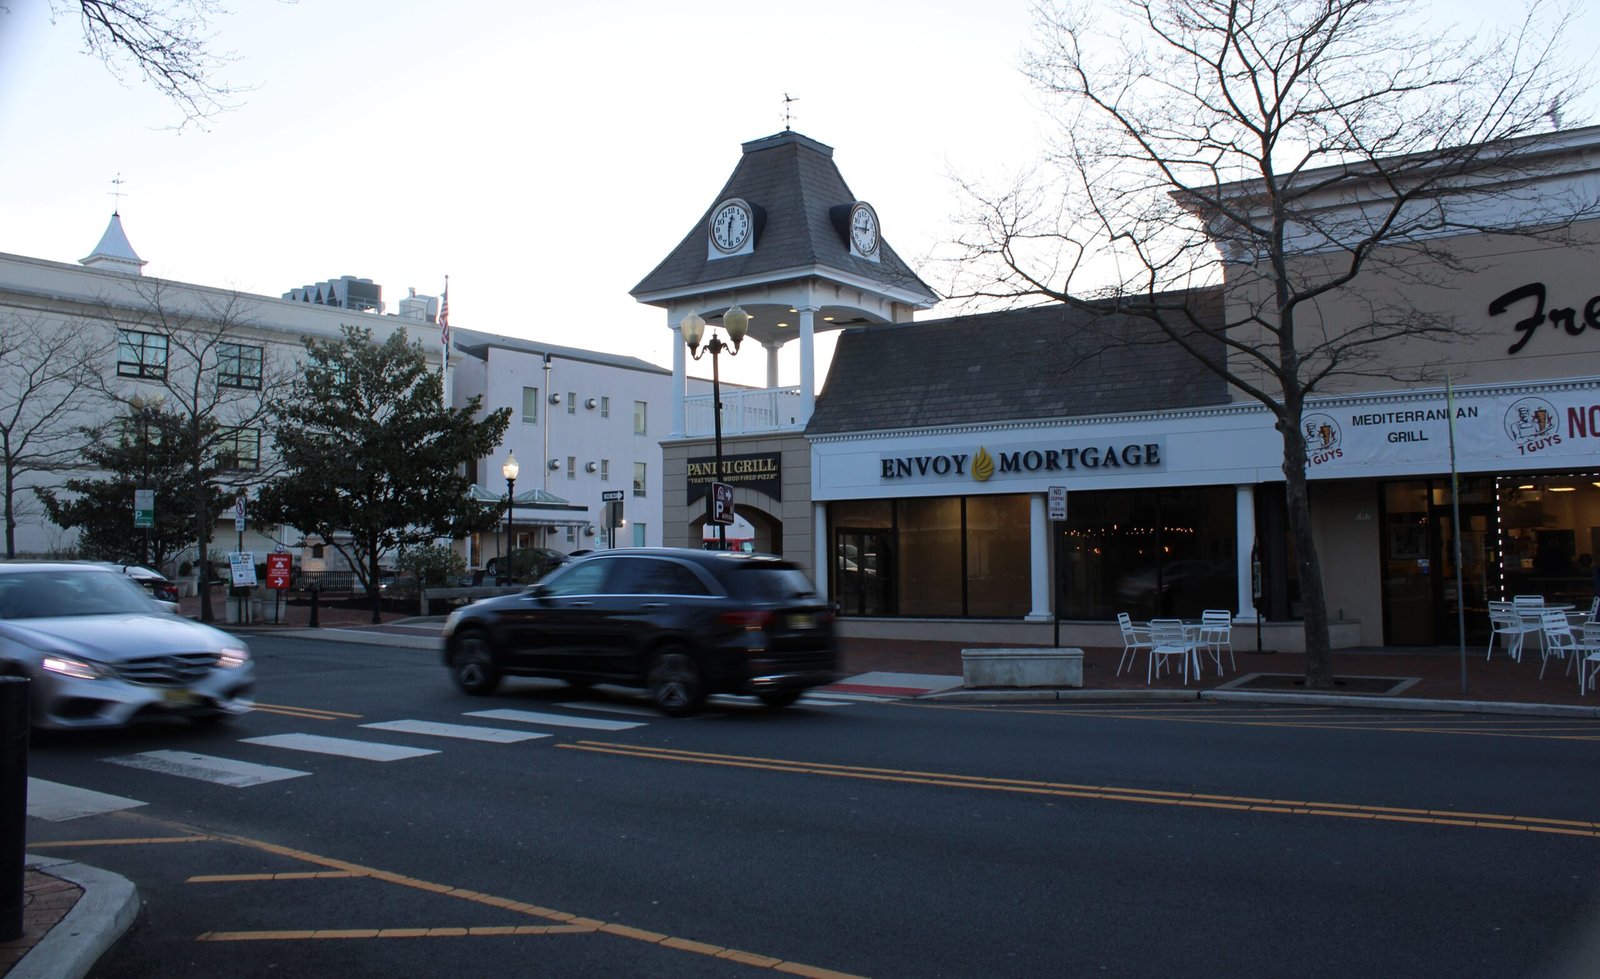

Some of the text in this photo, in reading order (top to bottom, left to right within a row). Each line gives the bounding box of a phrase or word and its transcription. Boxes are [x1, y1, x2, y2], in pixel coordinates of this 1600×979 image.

[1388, 430, 1429, 443] GRILL
[1527, 434, 1561, 452] GUYS
[881, 444, 1160, 478] ENVOY MORTGAGE
[1313, 448, 1343, 465] GUYS
[734, 458, 776, 473] GRILL
